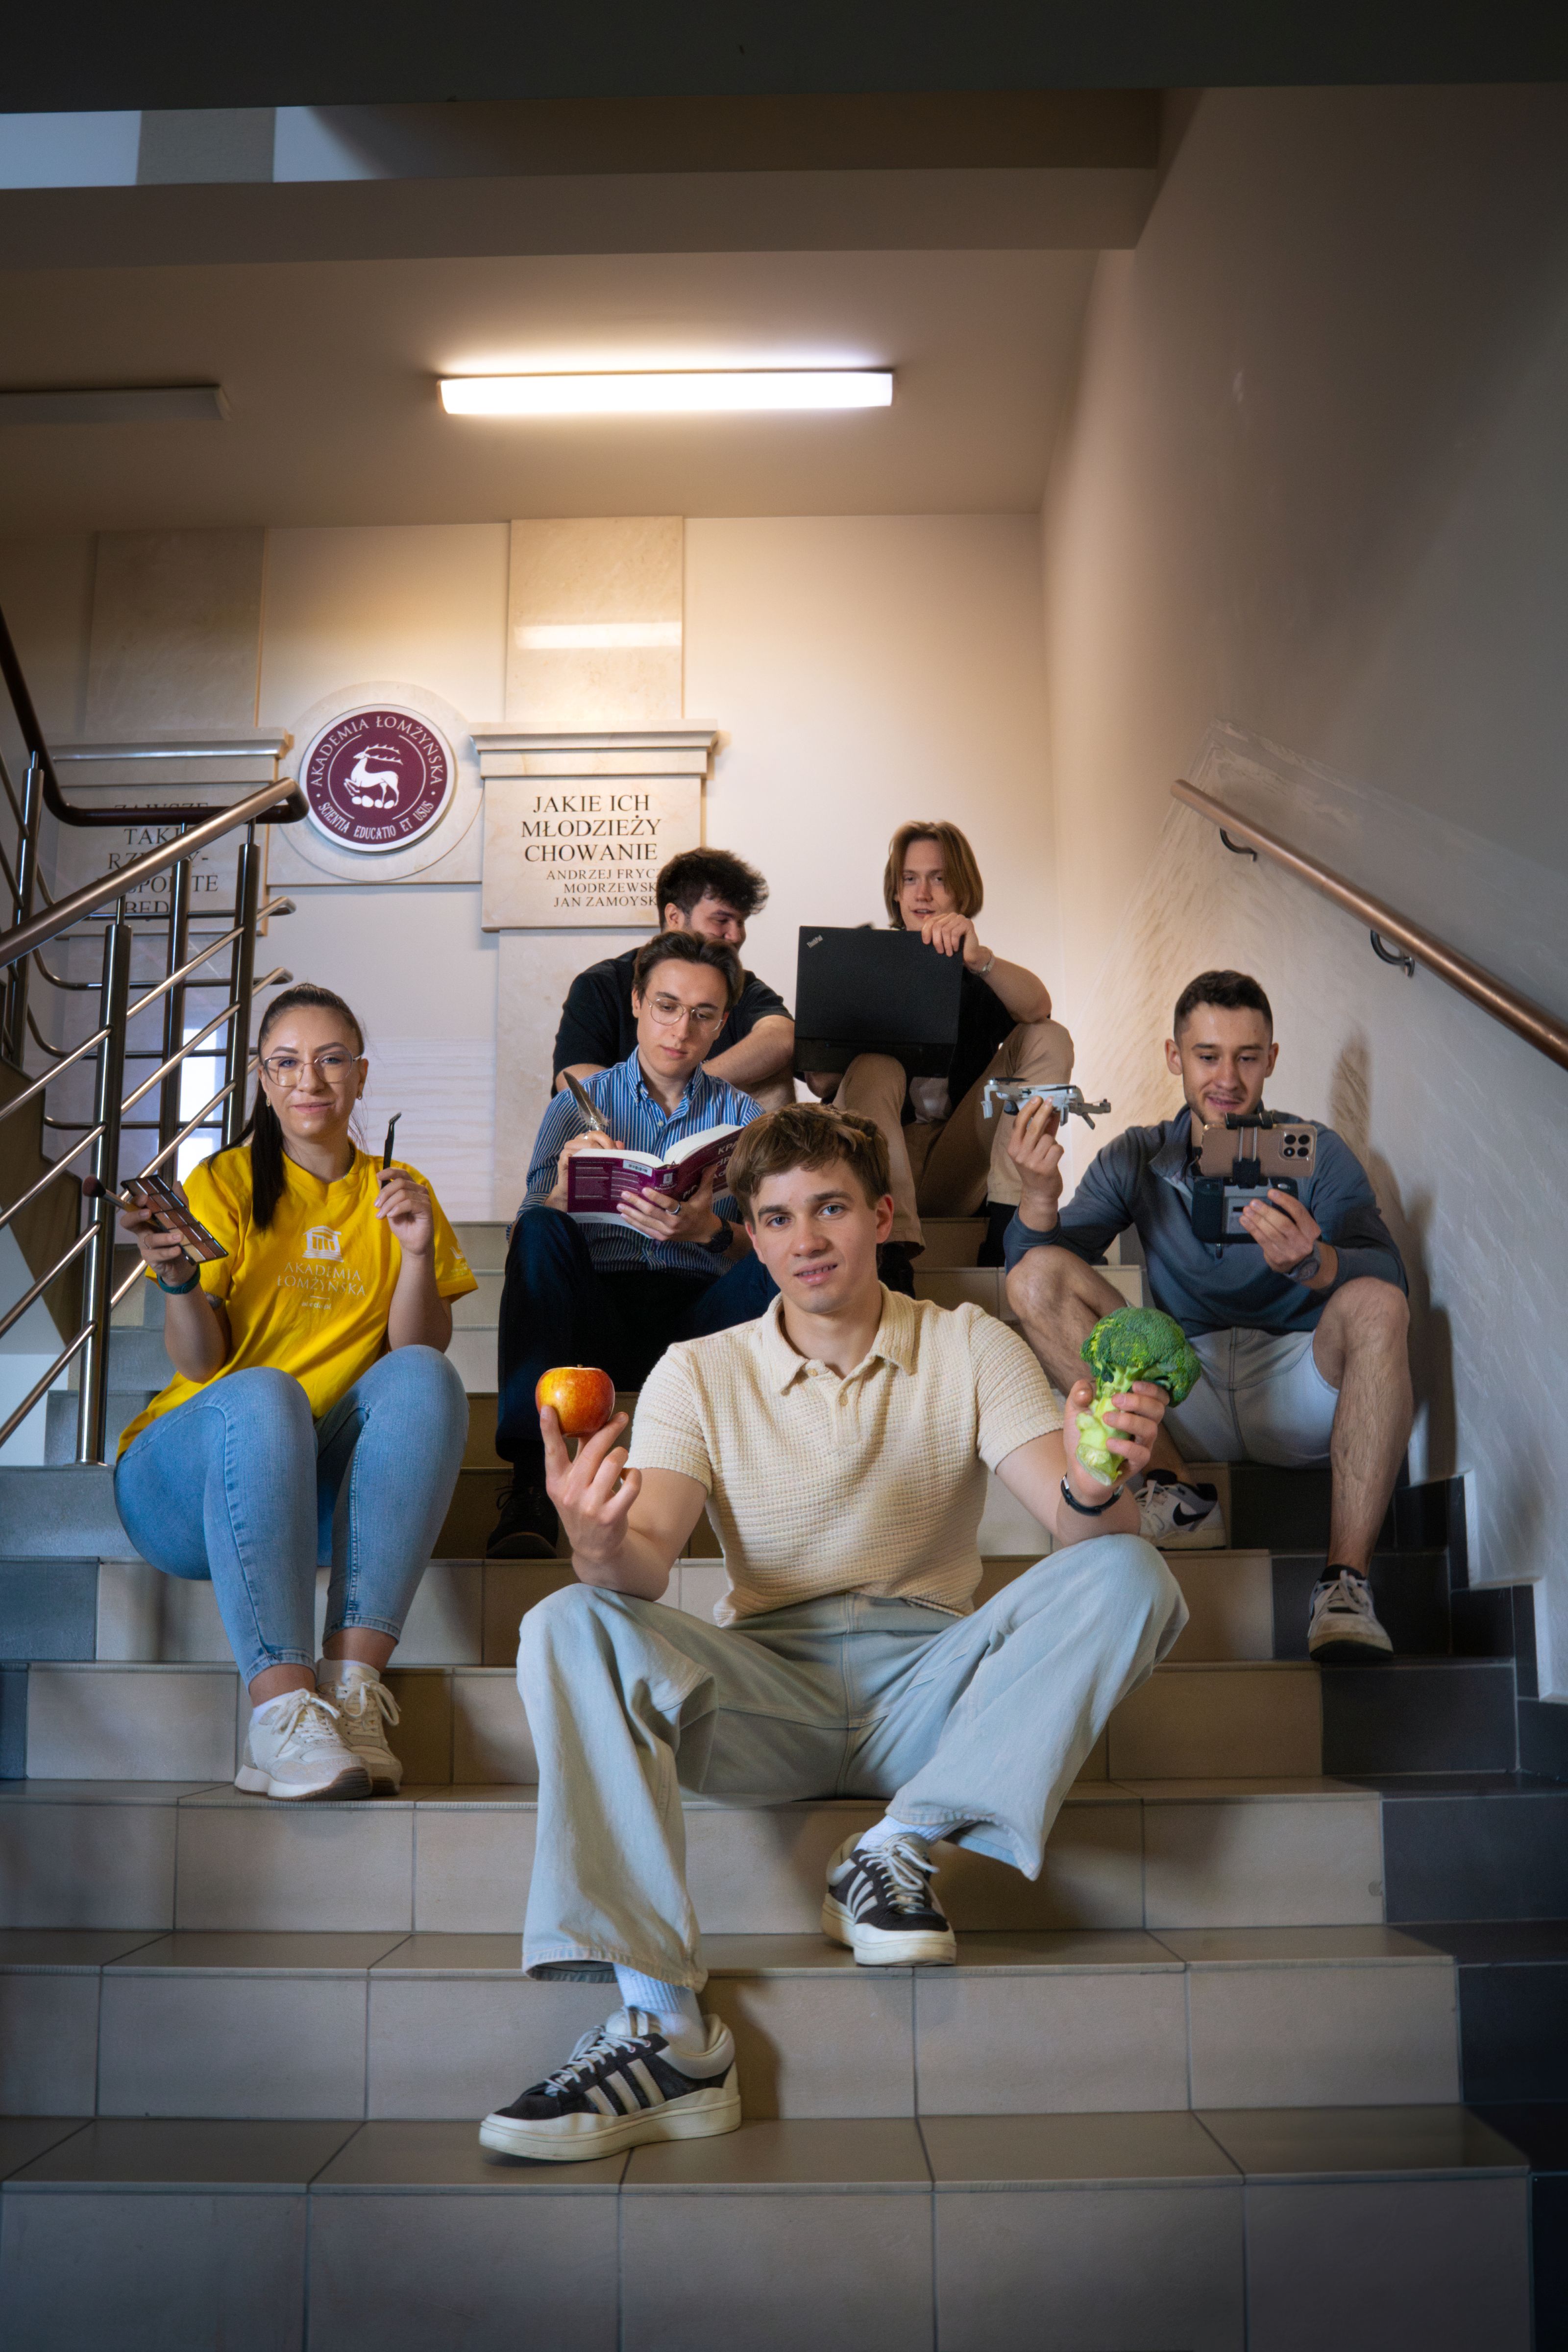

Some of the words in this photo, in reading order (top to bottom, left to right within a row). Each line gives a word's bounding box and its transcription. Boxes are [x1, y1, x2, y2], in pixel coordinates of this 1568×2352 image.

[311, 719, 369, 787] AKADEMIA
[376, 716, 443, 784] ŁOMŻYŃSKA
[533, 796, 601, 813] JAKIE
[610, 795, 650, 811] ICH
[318, 802, 350, 833] SCIENTIA
[353, 825, 396, 840] EDUCATIO
[399, 818, 413, 832] ET
[413, 801, 434, 822] USUS
[521, 815, 661, 837] MŁODZIEŻY
[525, 843, 658, 862] CHOWANIE
[546, 869, 612, 880] ANDRZEJ
[564, 882, 657, 893] MODRZEWSK
[554, 897, 581, 907] JAN
[586, 896, 657, 906] ZAMOYSK
